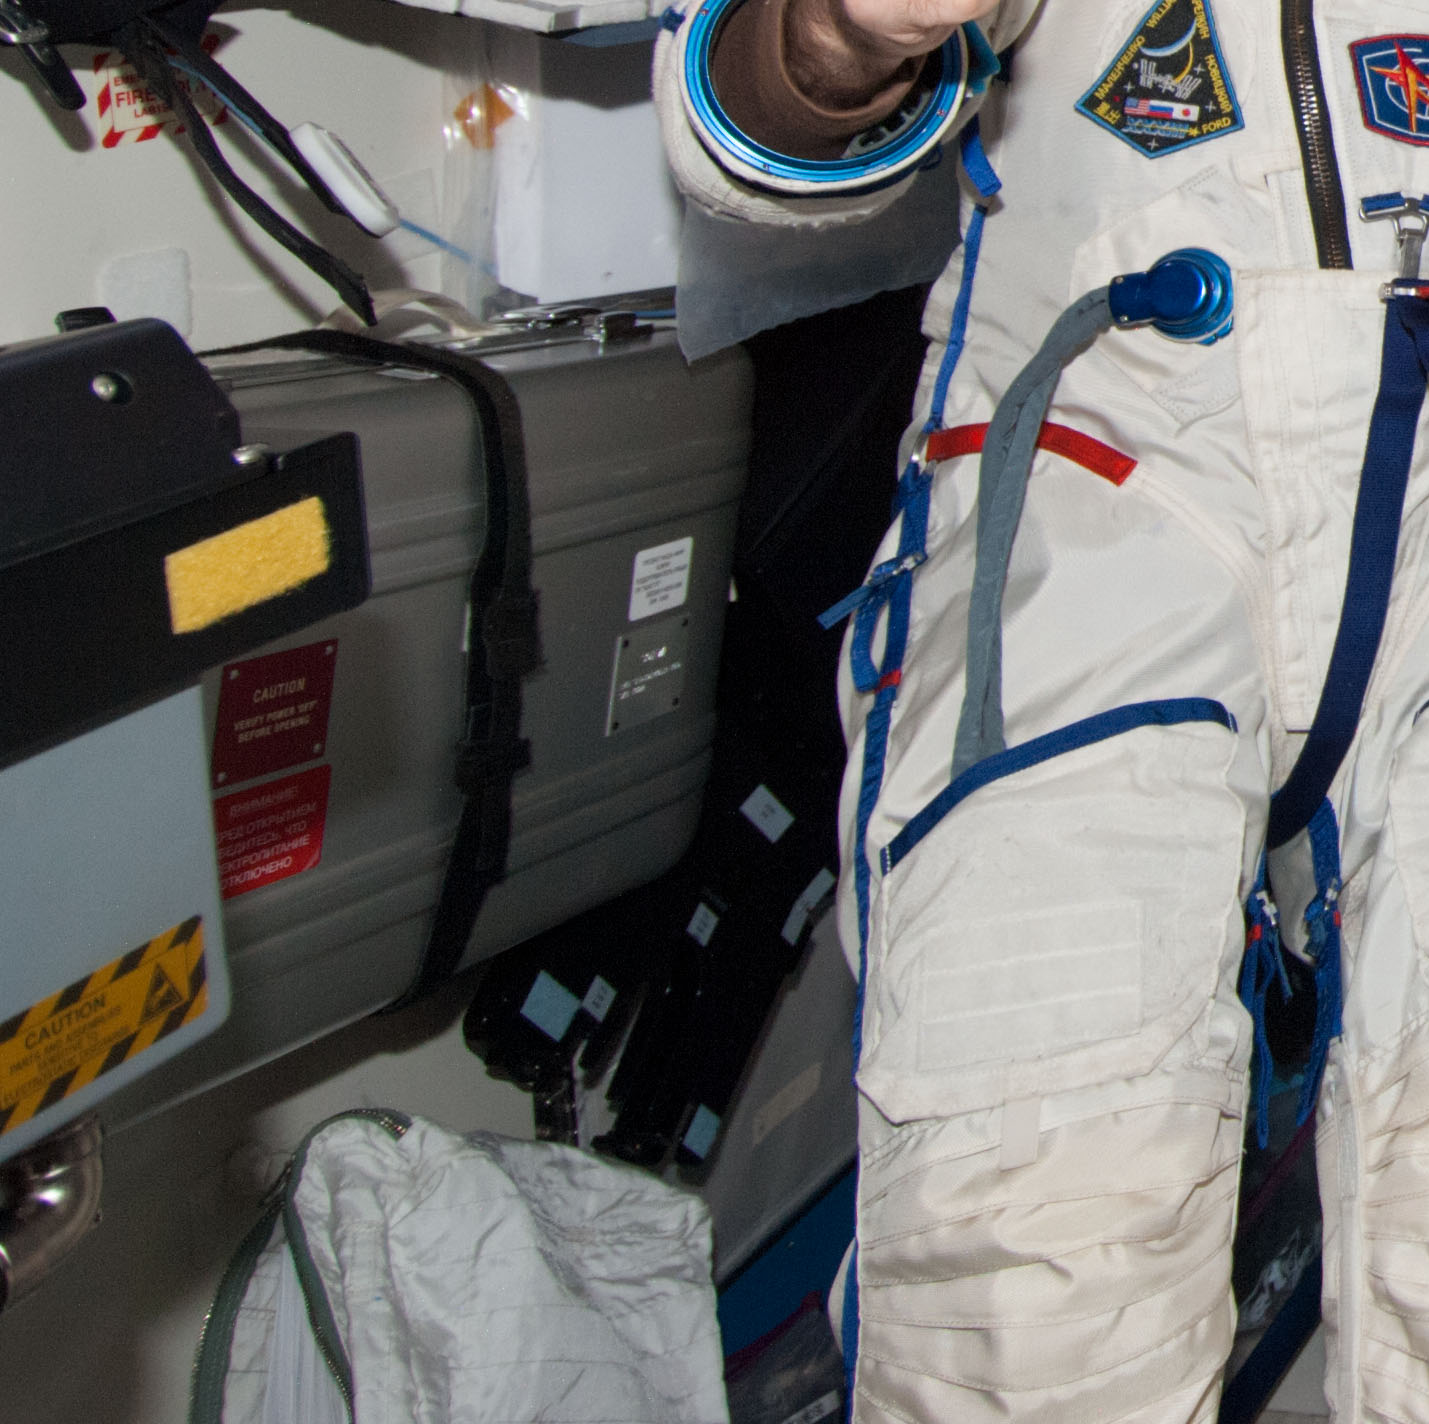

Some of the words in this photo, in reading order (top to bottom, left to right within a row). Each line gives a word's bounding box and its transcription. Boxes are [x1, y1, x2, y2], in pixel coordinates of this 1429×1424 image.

[1202, 116, 1232, 134] FORD
[253, 677, 306, 703] CAUTION
[237, 724, 273, 743] BEFORE
[284, 820, 308, 837] ЧТО
[219, 834, 311, 875] ЕКТРОПИТАНИЕ
[24, 994, 108, 1051] CAUTION
